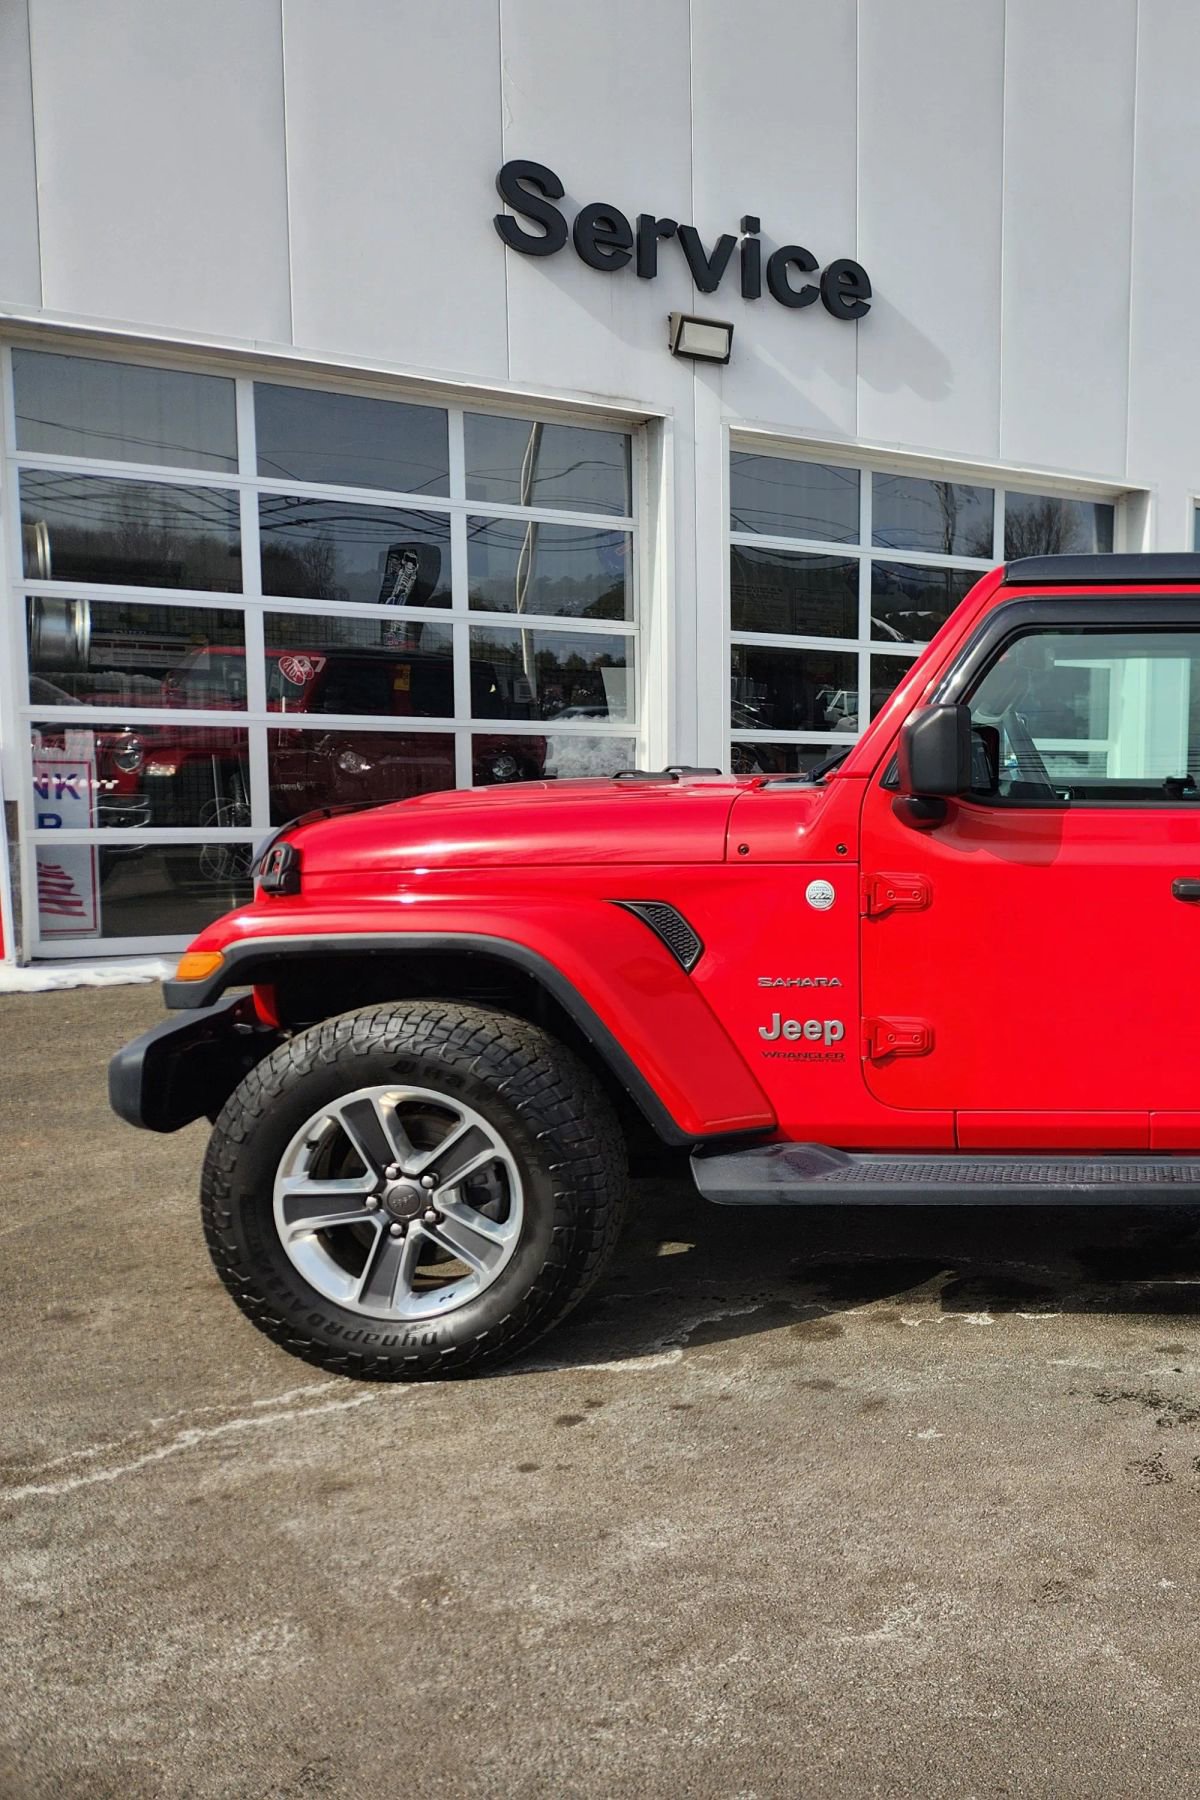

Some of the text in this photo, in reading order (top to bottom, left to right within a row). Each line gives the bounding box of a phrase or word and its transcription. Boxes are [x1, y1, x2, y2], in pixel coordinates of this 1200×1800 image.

[493, 159, 872, 320] Service
[757, 977, 843, 988] SAHARA
[758, 1012, 845, 1047] Jeep
[761, 1051, 845, 1060] WRANGLER
